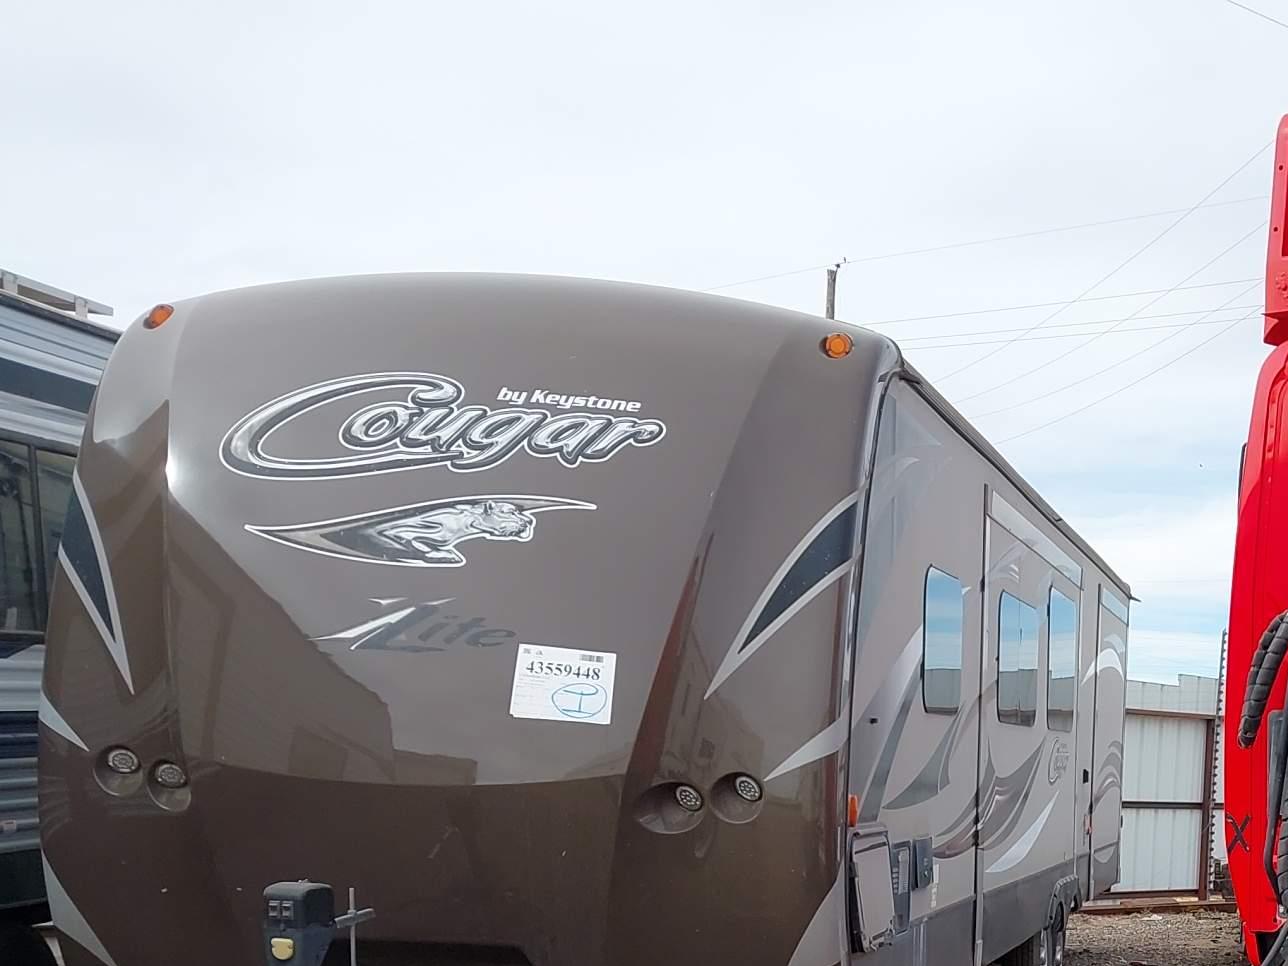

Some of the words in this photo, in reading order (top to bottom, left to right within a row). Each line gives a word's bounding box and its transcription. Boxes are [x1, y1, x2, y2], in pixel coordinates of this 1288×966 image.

[496, 387, 528, 405] by
[529, 389, 642, 412] Keystone
[219, 372, 667, 480] Cougar
[525, 660, 601, 681] 43559448
